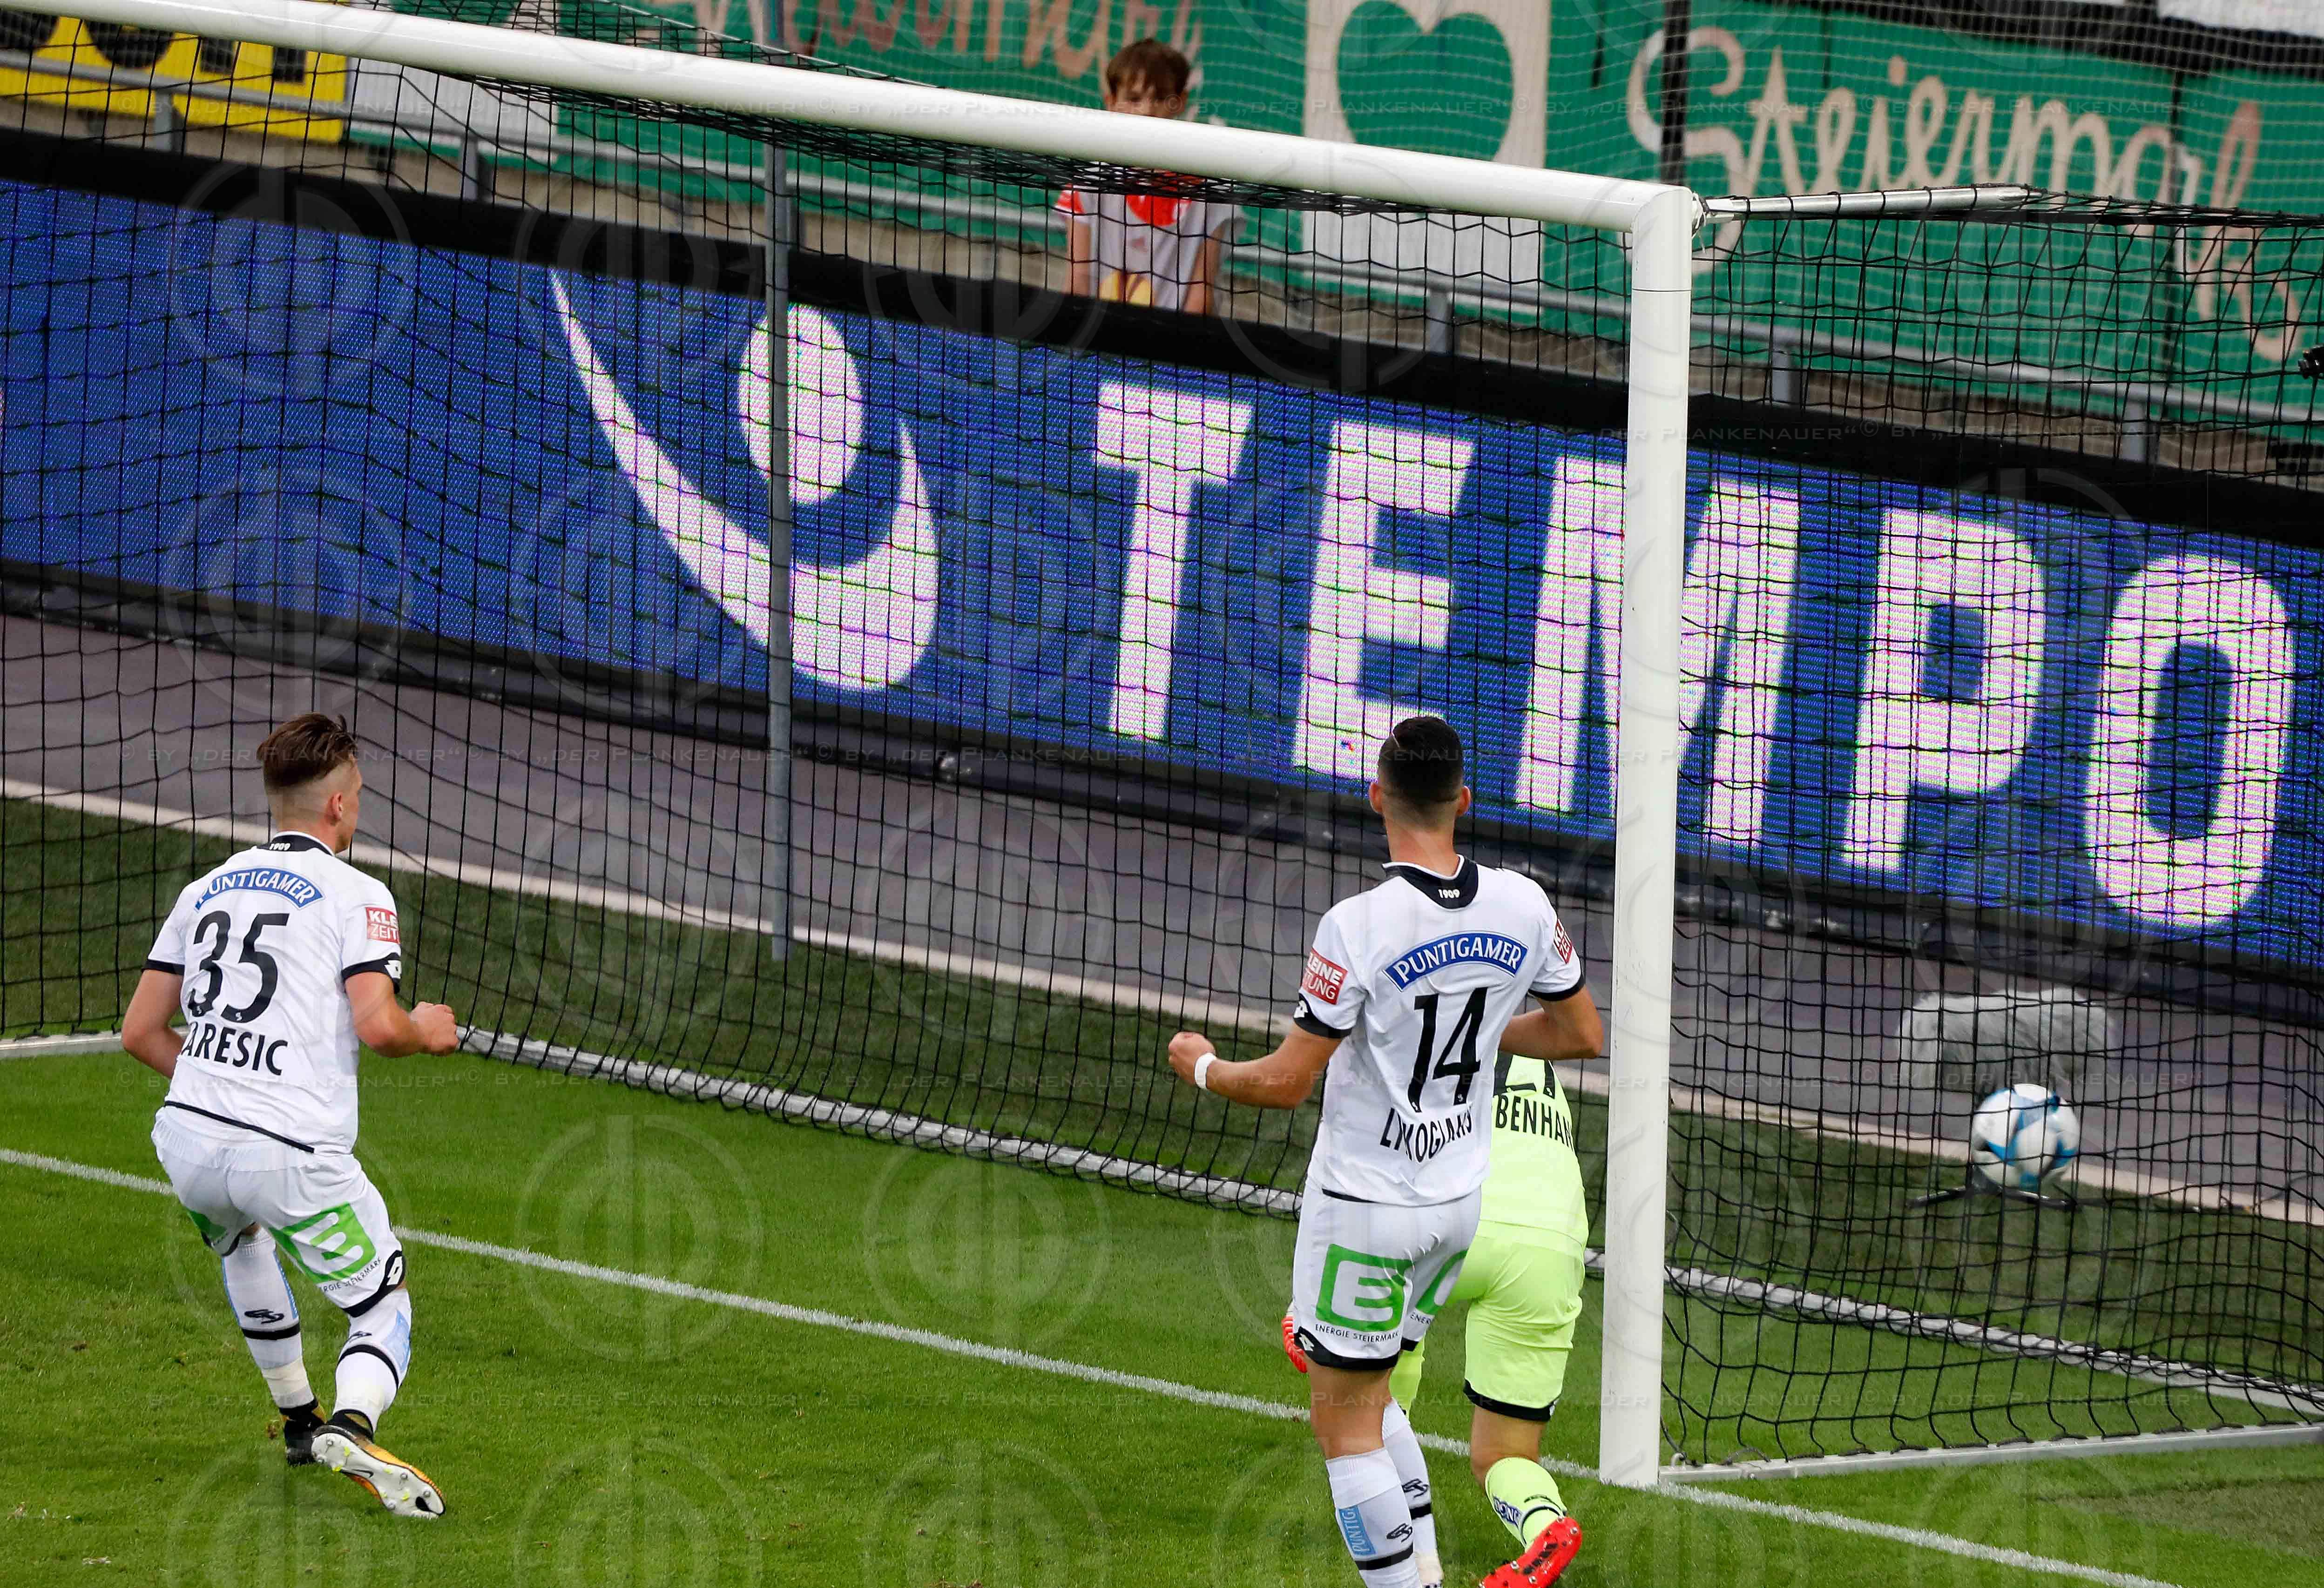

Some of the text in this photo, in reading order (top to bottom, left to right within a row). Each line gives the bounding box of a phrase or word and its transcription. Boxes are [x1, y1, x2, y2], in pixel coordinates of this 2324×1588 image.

[1093, 380, 2295, 926] TEMPO
[1438, 888, 1460, 899] 1909
[187, 910, 290, 1023] 35
[1393, 937, 1522, 982] PUNTIGAMER
[1414, 987, 1488, 1113] 14
[1315, 1323, 1349, 1338] ENERGIE
